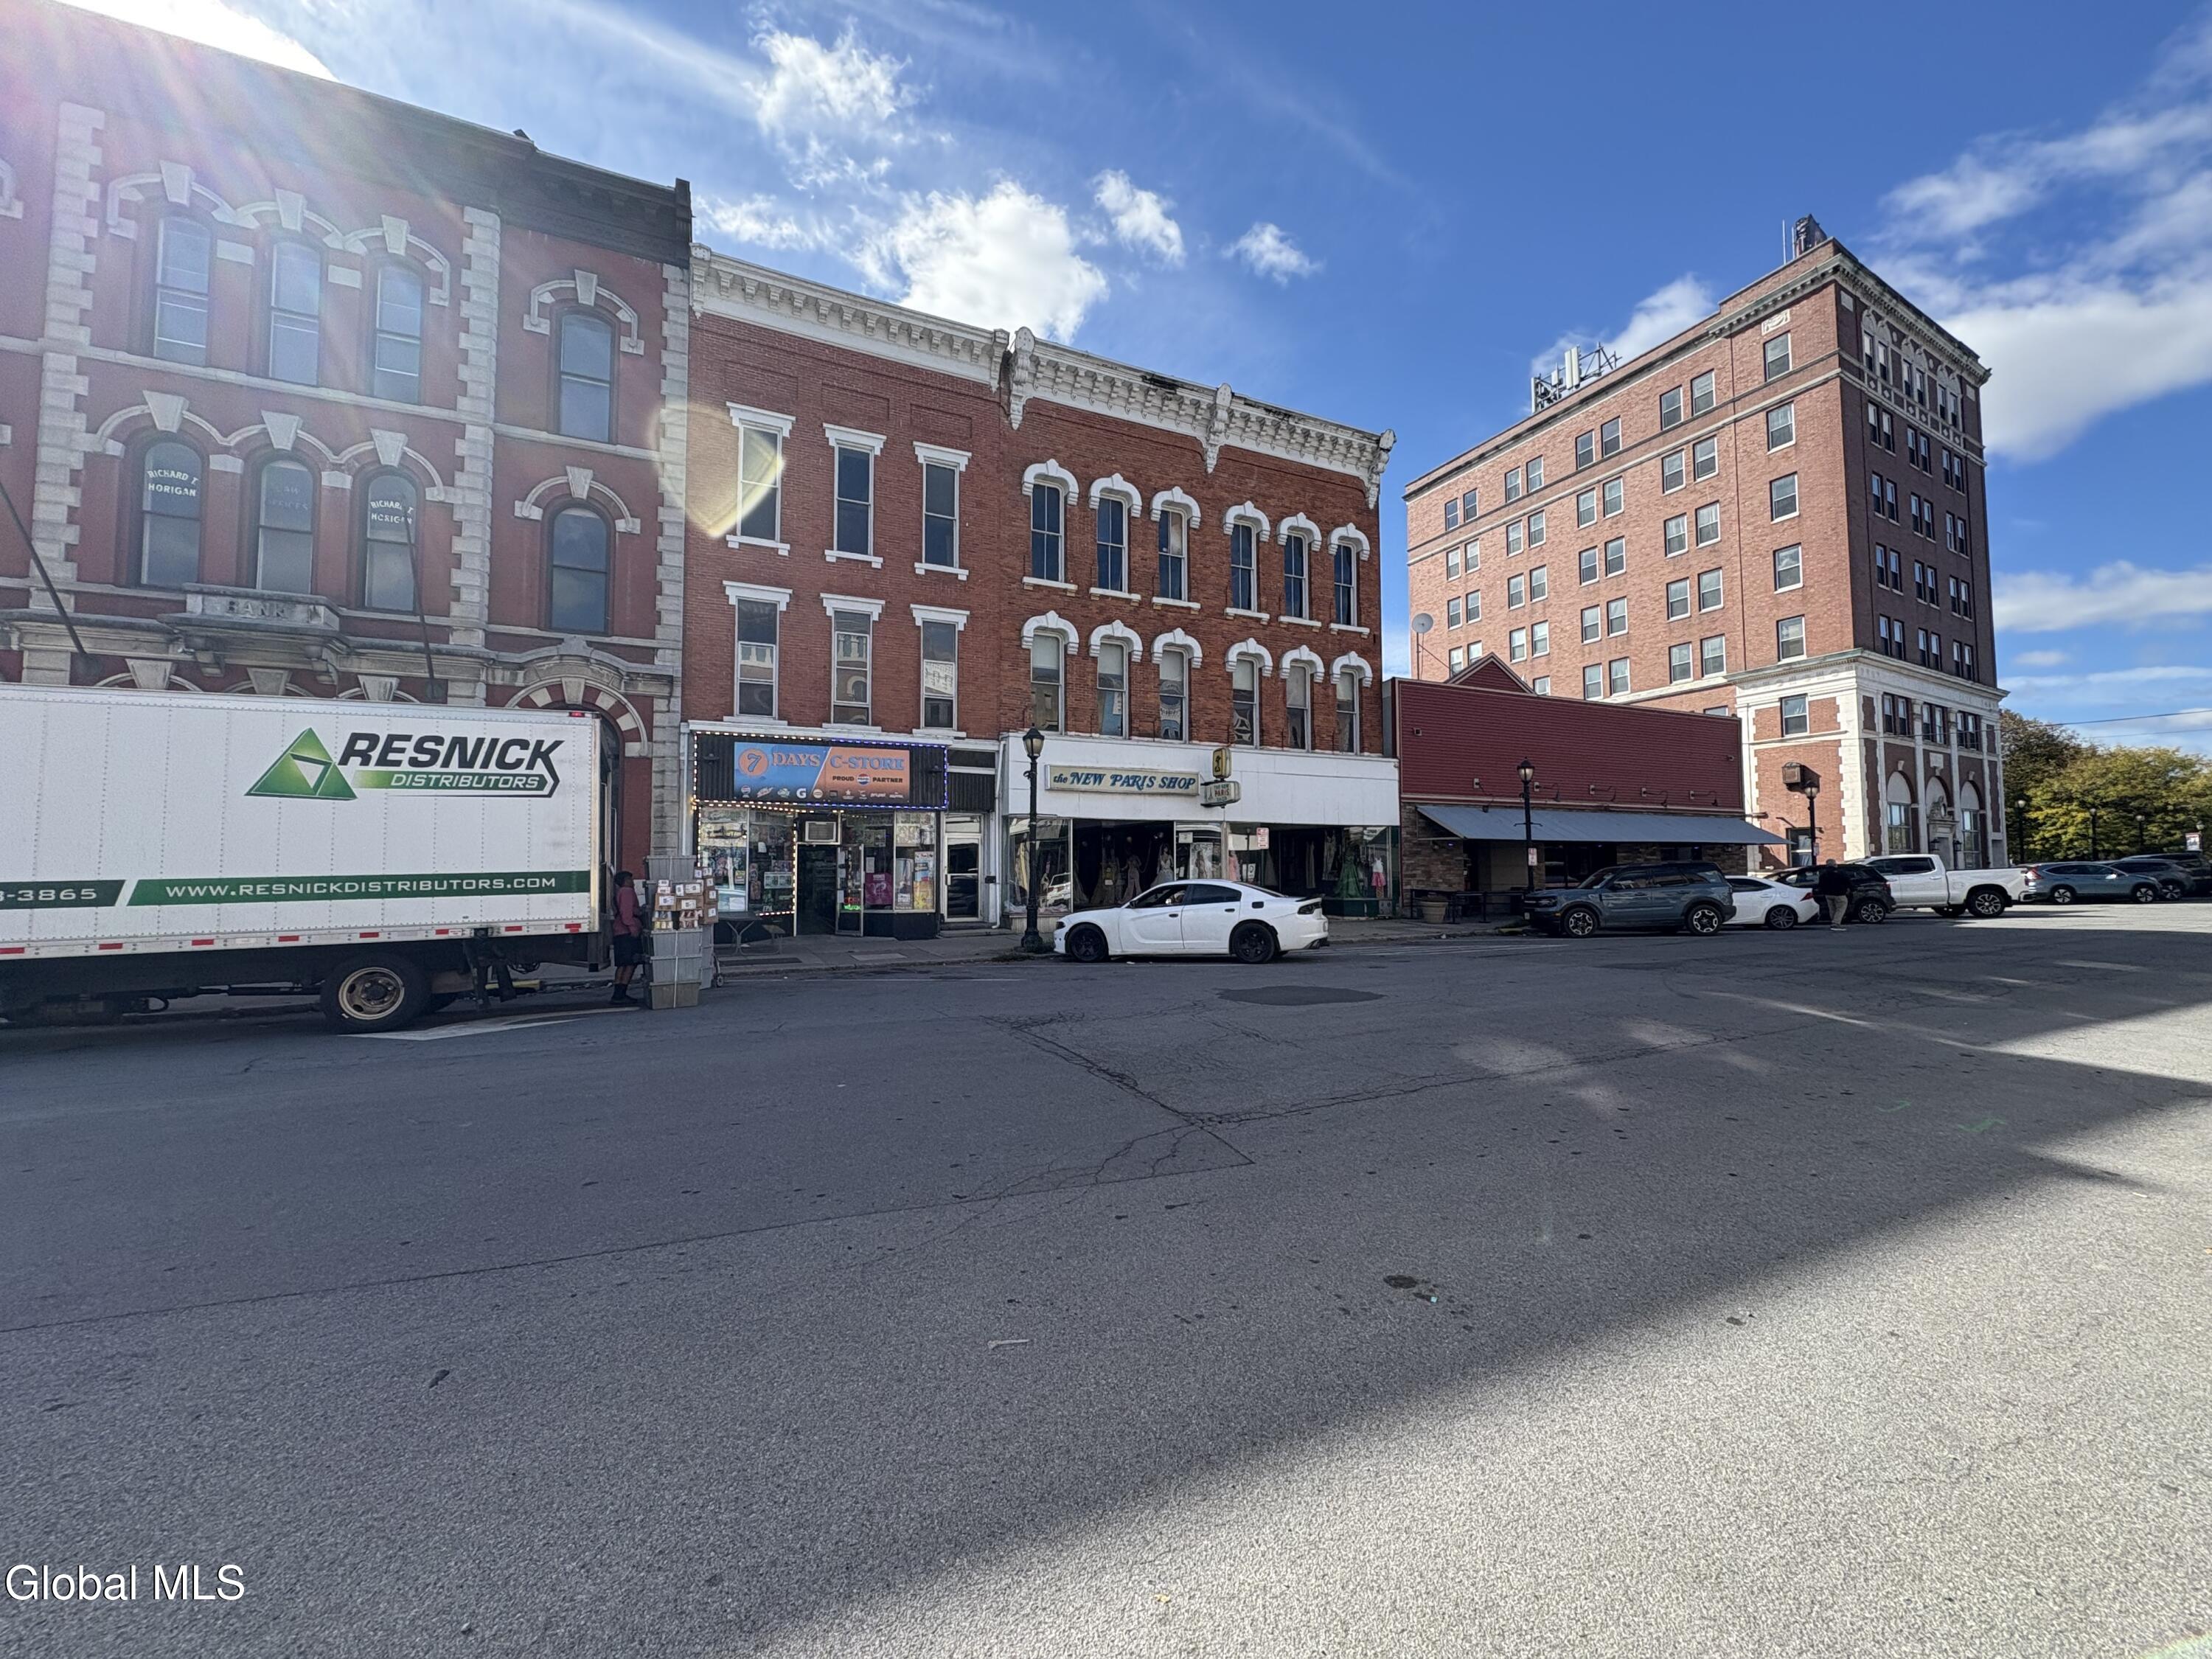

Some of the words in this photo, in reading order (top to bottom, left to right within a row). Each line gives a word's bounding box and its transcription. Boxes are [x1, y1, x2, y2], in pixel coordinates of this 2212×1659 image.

[147, 469, 189, 481] RICHARD
[148, 483, 196, 497] HORIGAN
[370, 500, 403, 510] RICHAR
[226, 599, 289, 619] BANK
[337, 732, 565, 772] RESNICK
[747, 754, 761, 773] 7
[772, 752, 821, 767] DAYS
[830, 754, 905, 771] C-STORE
[391, 773, 540, 789] DISTRIBUTORS
[1053, 773, 1068, 784] the
[1070, 772, 1106, 785] NEW
[1110, 773, 1157, 791] PARIS
[1158, 776, 1196, 790] SHOP
[796, 787, 807, 799] G
[1214, 788, 1229, 797] PARIS
[165, 877, 556, 898] WWW.RESNICKDISTRIBUTORS.COM
